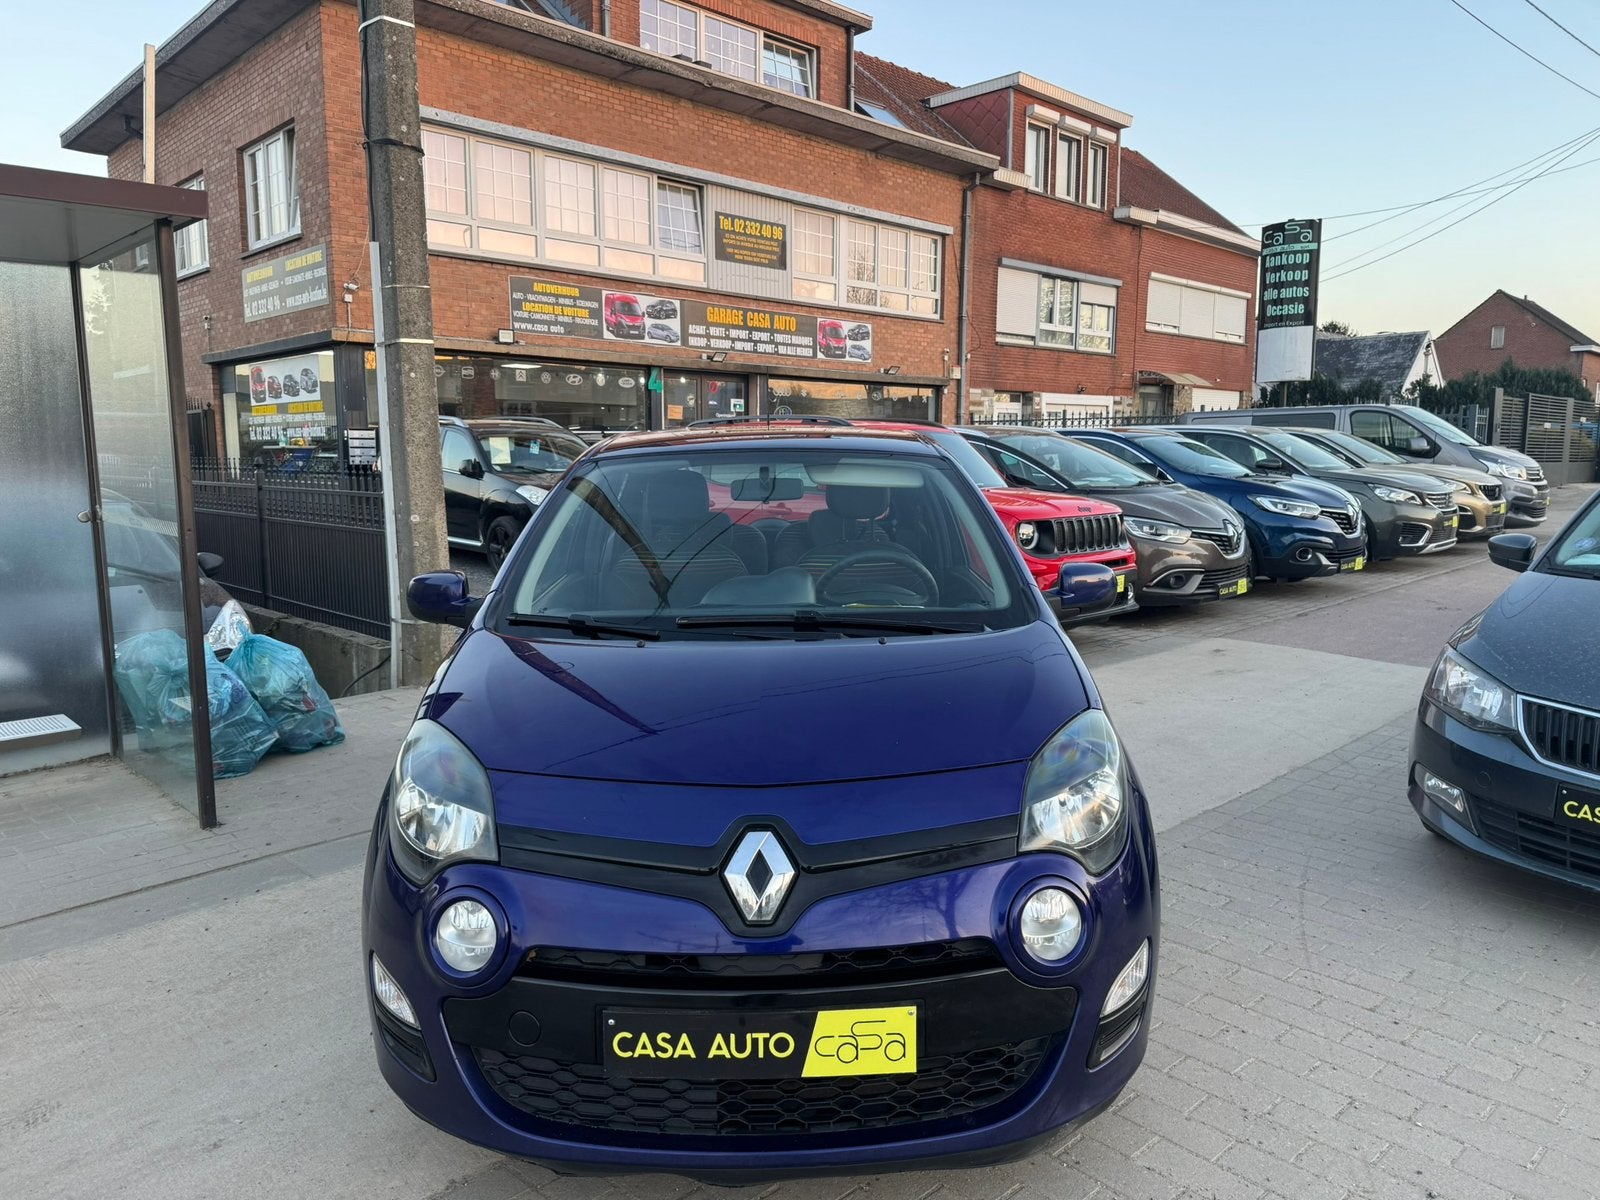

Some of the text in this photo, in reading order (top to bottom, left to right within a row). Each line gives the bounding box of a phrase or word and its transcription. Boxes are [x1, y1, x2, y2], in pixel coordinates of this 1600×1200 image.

[734, 218, 744, 233] 02
[746, 220, 760, 236] 332
[762, 224, 771, 238] 40
[773, 226, 783, 240] 96
[1265, 253, 1310, 268] Aankoop
[1265, 270, 1309, 284] Verkoop
[1264, 286, 1309, 301] alle autos
[522, 302, 590, 318] LOCATION DE VOITURE
[1267, 302, 1304, 317] Occasie
[706, 306, 796, 332] GARAGE CASA AUTO
[550, 324, 565, 334] auto
[688, 324, 706, 335] ACHAT
[709, 327, 725, 337] VENTE
[730, 329, 748, 339] IMPORT
[752, 331, 770, 341] EXPORT
[774, 333, 791, 344] TOUTES
[735, 341, 754, 351] IMPORT
[757, 343, 775, 353] EXPORT
[612, 1032, 696, 1059] CASA
[708, 1032, 794, 1059] AUTO
